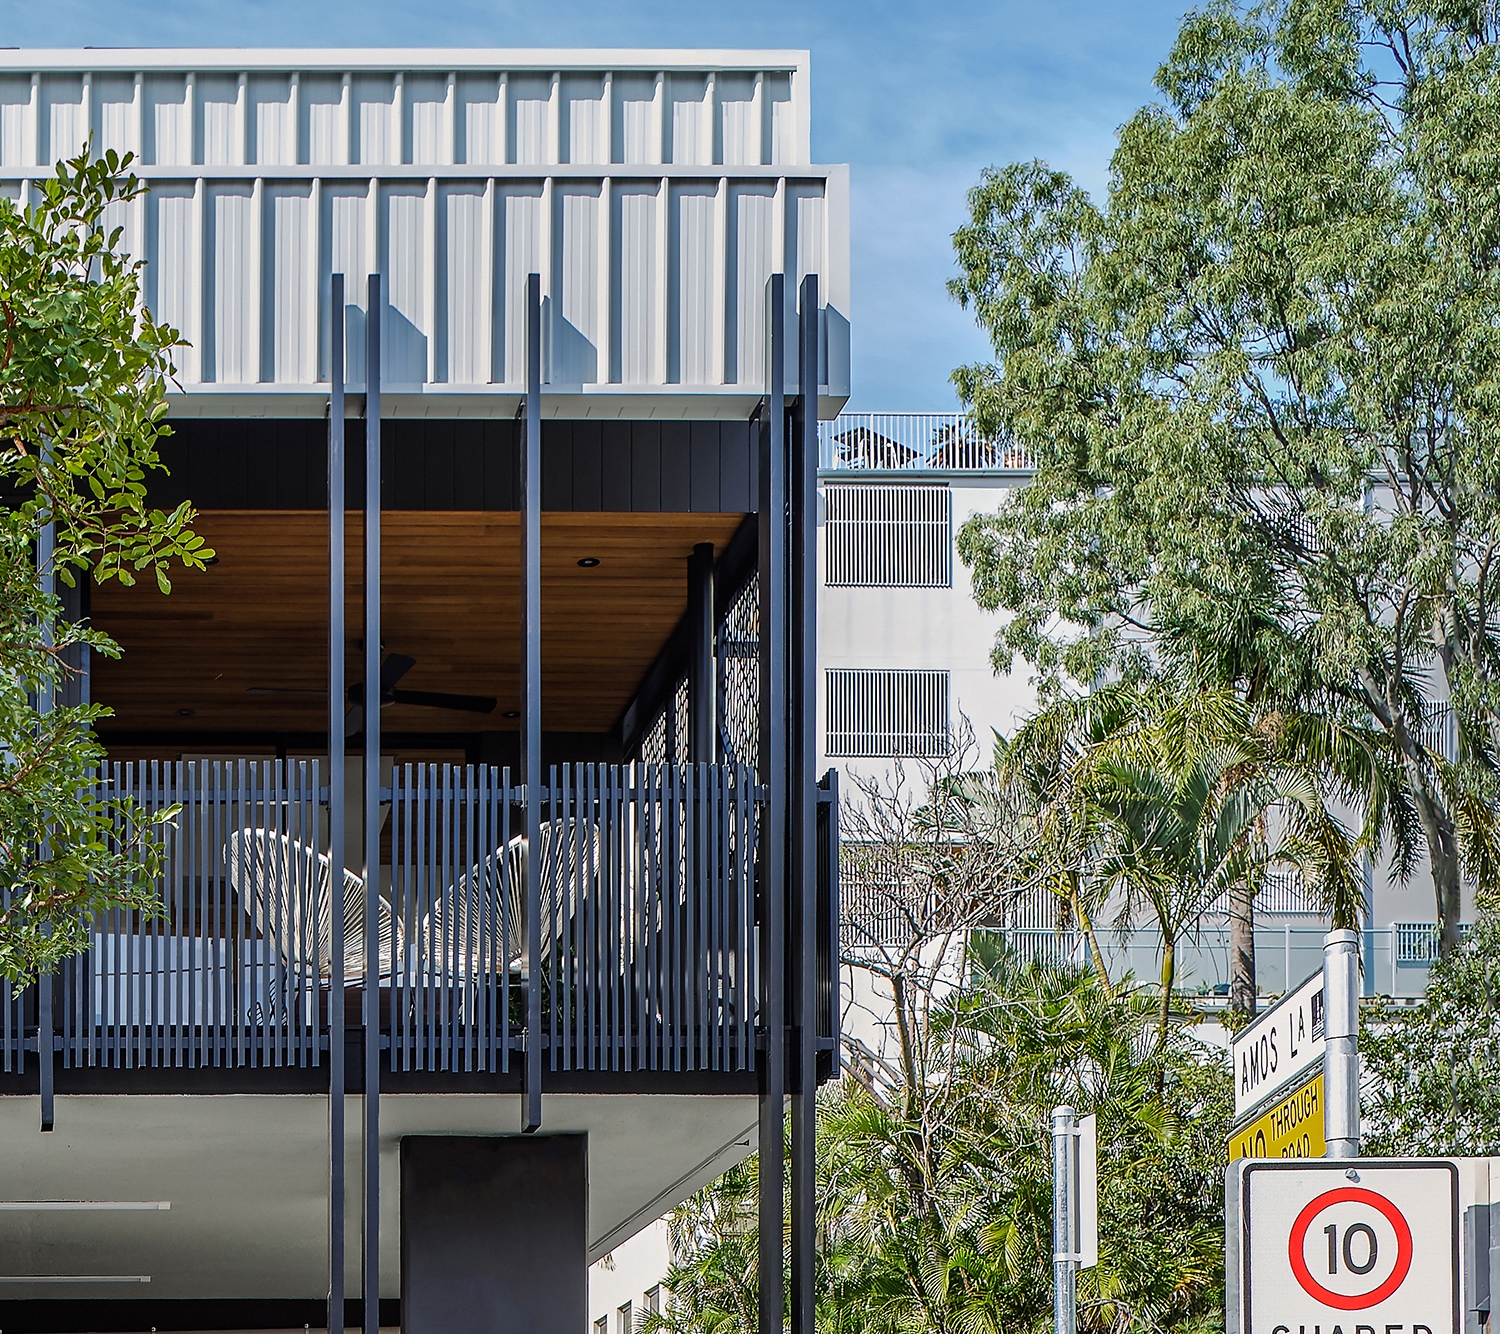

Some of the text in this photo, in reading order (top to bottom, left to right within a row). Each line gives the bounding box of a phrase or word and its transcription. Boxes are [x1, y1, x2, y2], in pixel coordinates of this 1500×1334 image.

[1241, 1005, 1305, 1097] AMOS LA
[1270, 1083, 1319, 1141] THROUGH
[1324, 1223, 1377, 1275] 10
